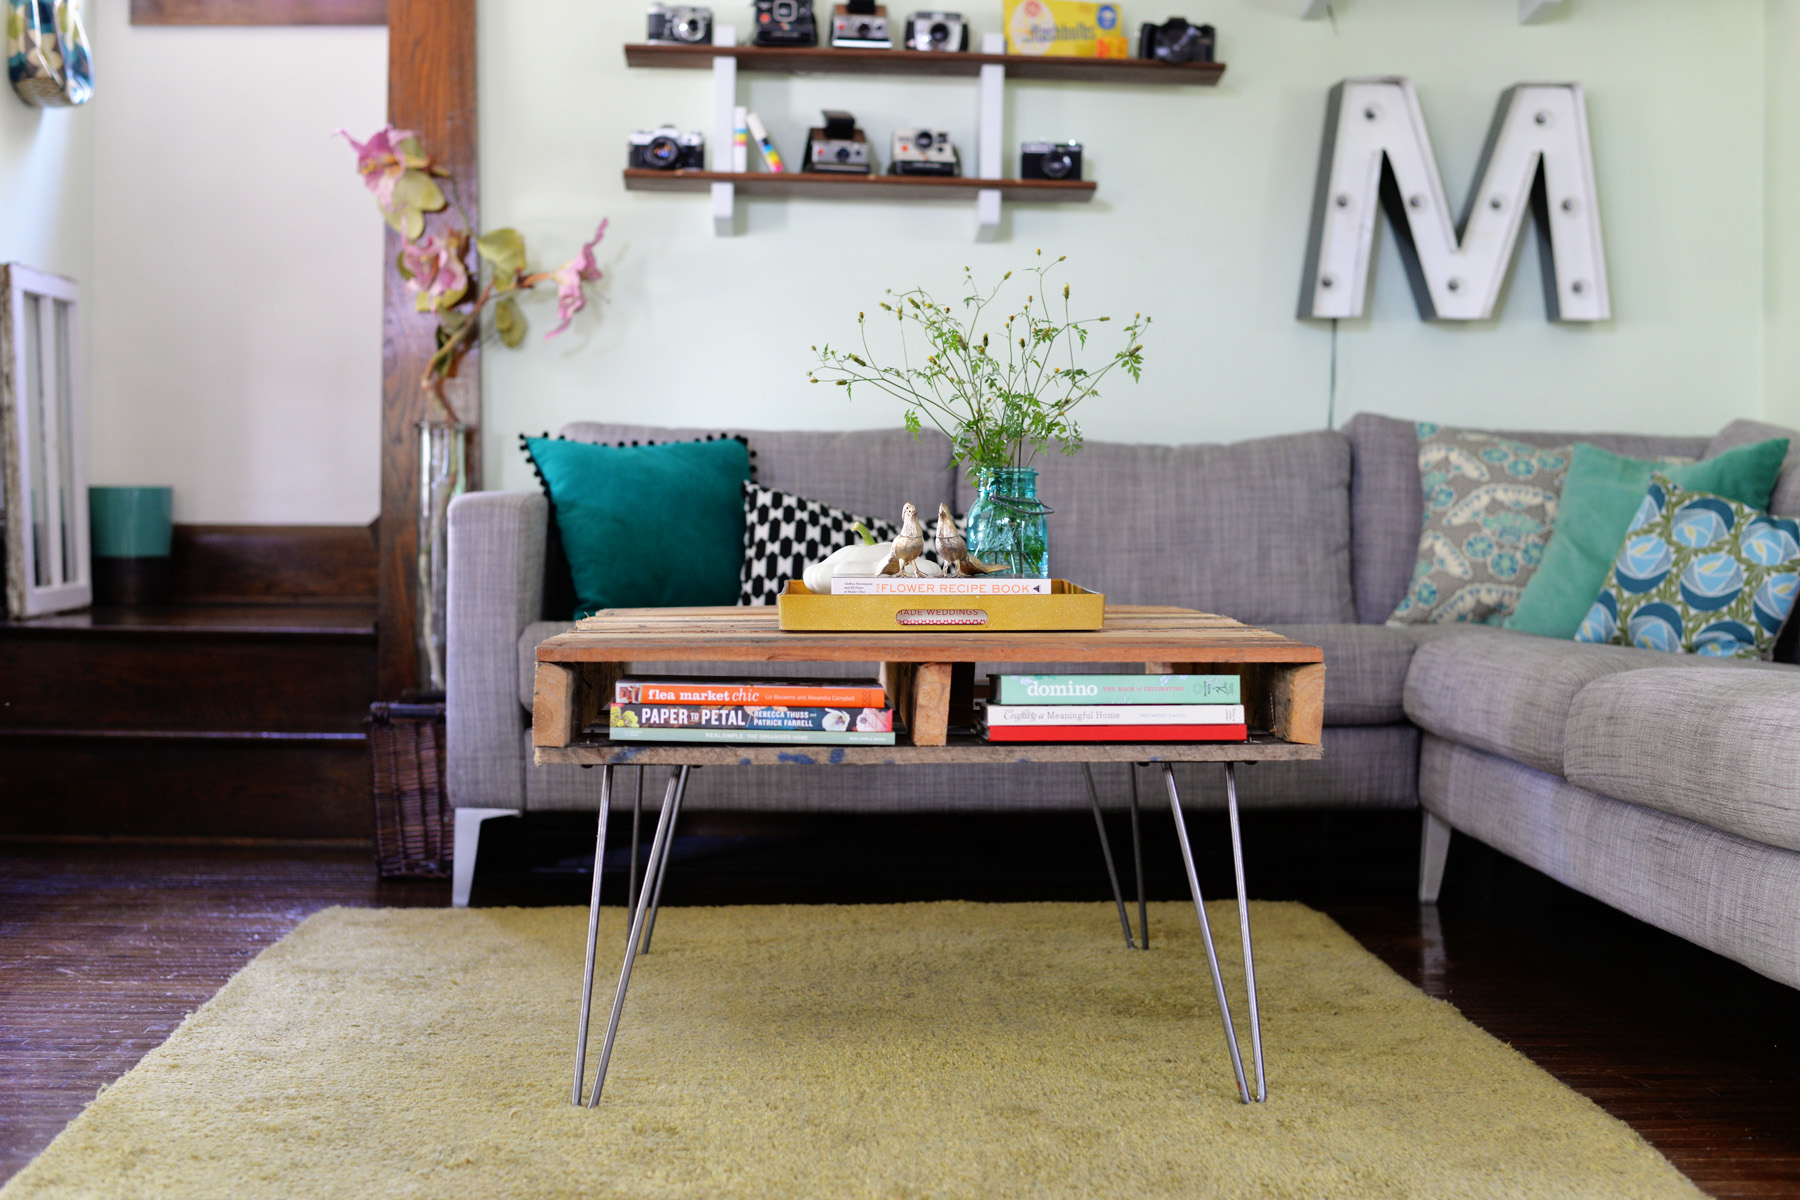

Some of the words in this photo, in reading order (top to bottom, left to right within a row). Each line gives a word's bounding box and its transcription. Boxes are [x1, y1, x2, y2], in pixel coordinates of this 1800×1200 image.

[1297, 76, 1611, 322] M
[881, 583, 935, 593] FLOWER
[939, 584, 987, 593] RECIPE
[992, 584, 1030, 594] BOOK
[1027, 680, 1098, 696] domino
[647, 689, 676, 700] flea
[679, 690, 729, 701] market
[731, 688, 760, 702] chic
[641, 707, 688, 724] PAPER
[690, 712, 699, 721] TO
[701, 709, 746, 726] PETAL
[753, 710, 785, 719] REBECCA
[786, 711, 809, 719] THUSS
[1047, 711, 1094, 721] Meaningful
[1095, 711, 1120, 720] Home
[753, 718, 785, 726] PATRICK
[785, 719, 813, 728] FARRELL
